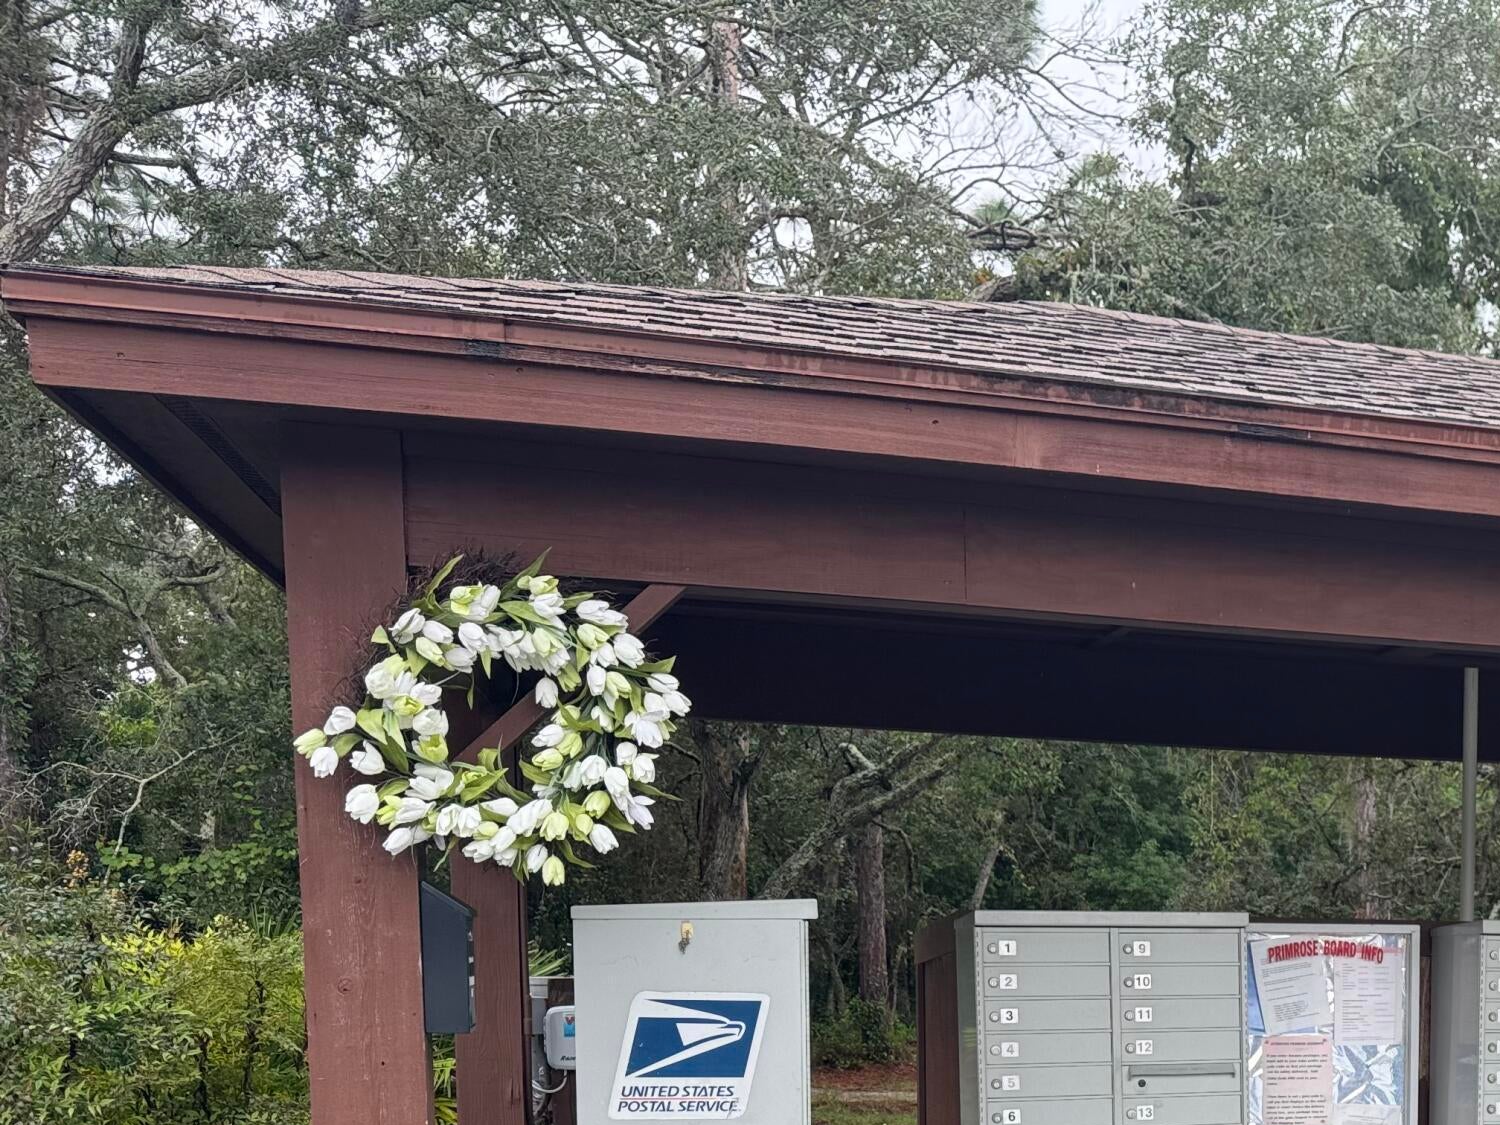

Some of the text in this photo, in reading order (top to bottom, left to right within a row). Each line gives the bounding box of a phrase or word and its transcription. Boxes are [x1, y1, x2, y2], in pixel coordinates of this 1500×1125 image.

[1138, 943, 1147, 954] 9
[1267, 940, 1384, 965] PRIMROSE BOARD INFO
[1004, 976, 1013, 988] 2
[1135, 976, 1151, 987] 10
[1005, 1010, 1014, 1022] 3
[1137, 1009, 1152, 1020] 11
[1006, 1044, 1015, 1056] 4
[1137, 1041, 1153, 1053] 12
[1007, 1077, 1016, 1089] 5
[621, 1085, 735, 1098] UNITED STATES
[617, 1100, 738, 1113] POSTAL SERVICE
[1007, 1111, 1017, 1122] 6
[1137, 1107, 1153, 1119] 13
